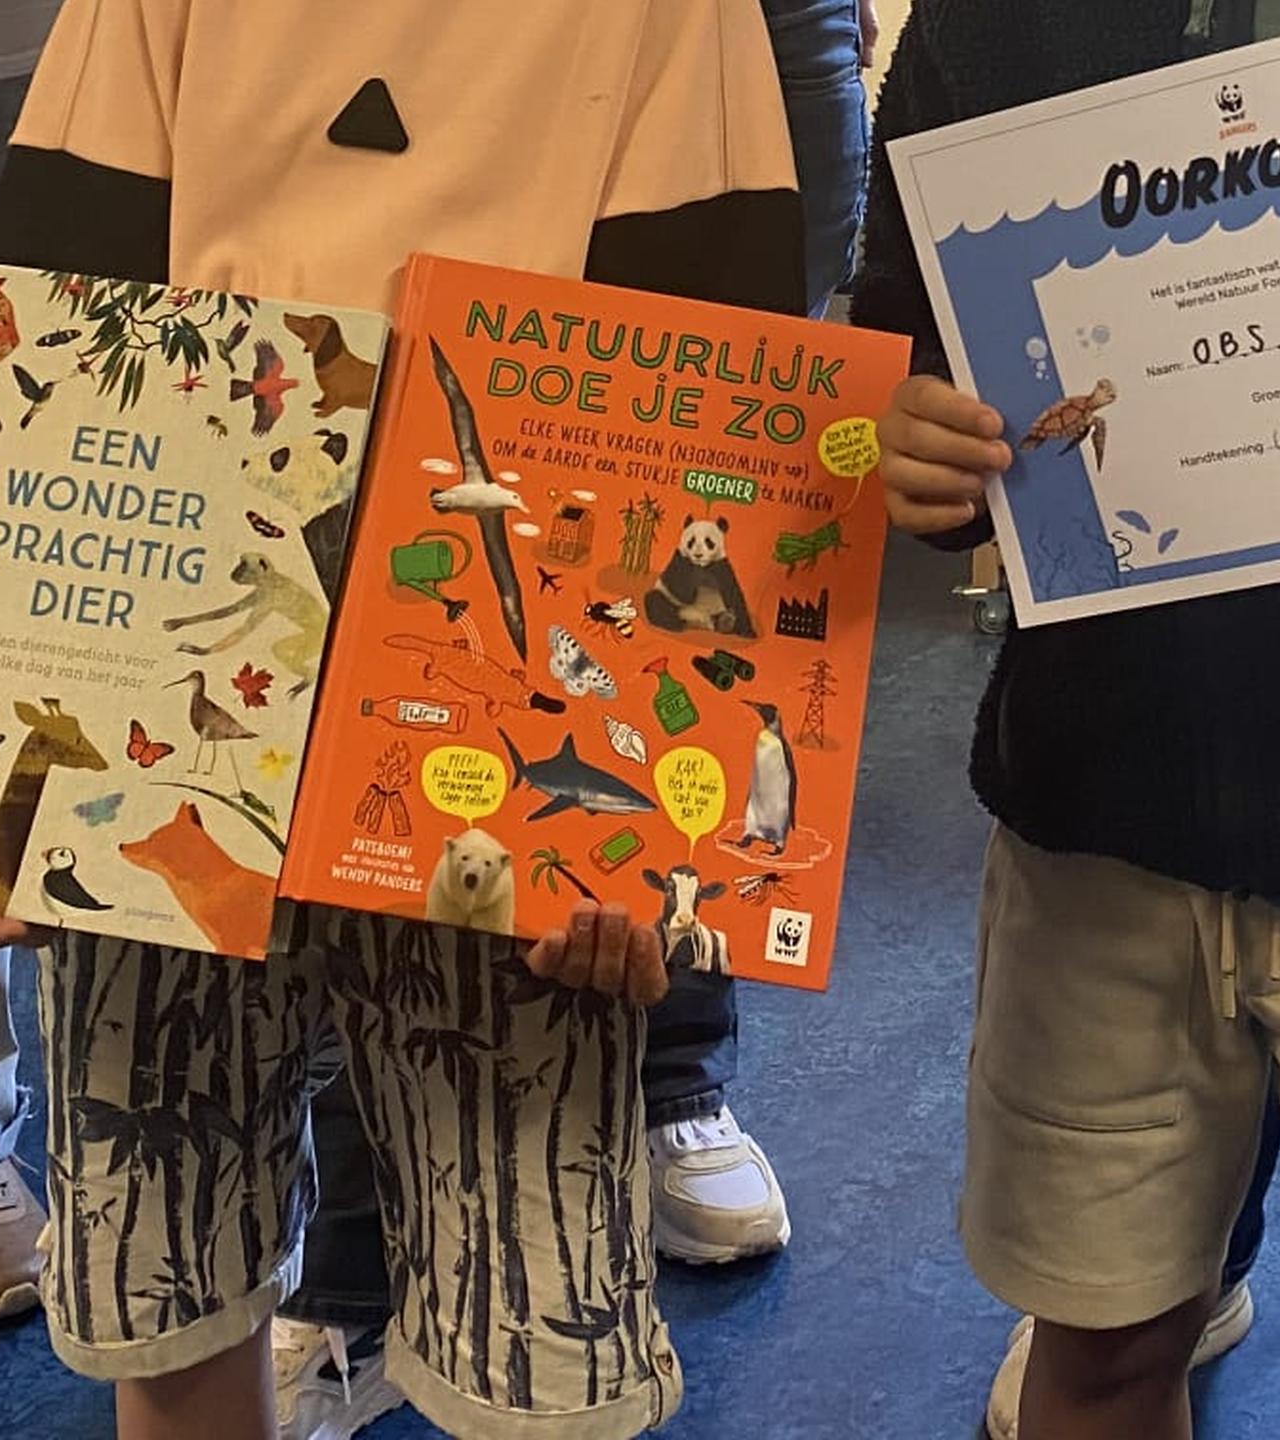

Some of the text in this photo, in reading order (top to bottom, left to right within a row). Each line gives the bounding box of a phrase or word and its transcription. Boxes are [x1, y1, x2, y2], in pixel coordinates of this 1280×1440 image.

[1150, 284, 1173, 300] Het
[1174, 281, 1187, 295] is
[1186, 266, 1256, 293] fantastisch
[1174, 291, 1217, 311] Wereld
[1218, 282, 1261, 301] Natuur
[1145, 361, 1185, 378] Naam:
[486, 358, 612, 413] DOE
[724, 396, 806, 444] ZO
[72, 426, 161, 471] EEN
[520, 418, 665, 460] ELKE WEEK VRAGEN
[492, 439, 518, 459] OM
[544, 447, 593, 471] AARDE
[623, 461, 679, 486] STUKJE
[686, 471, 754, 502] GROENER
[780, 487, 835, 511] MAKEN
[8, 468, 206, 530] WONDER
[30, 579, 134, 629] DIER
[20, 637, 120, 663] dierengedicht
[124, 653, 158, 669] voor
[25, 658, 53, 678] dag
[57, 665, 83, 680] van
[86, 668, 111, 683] het
[113, 674, 146, 689] jaar
[331, 863, 373, 885] WENDY
[373, 871, 424, 893] PANDERS
